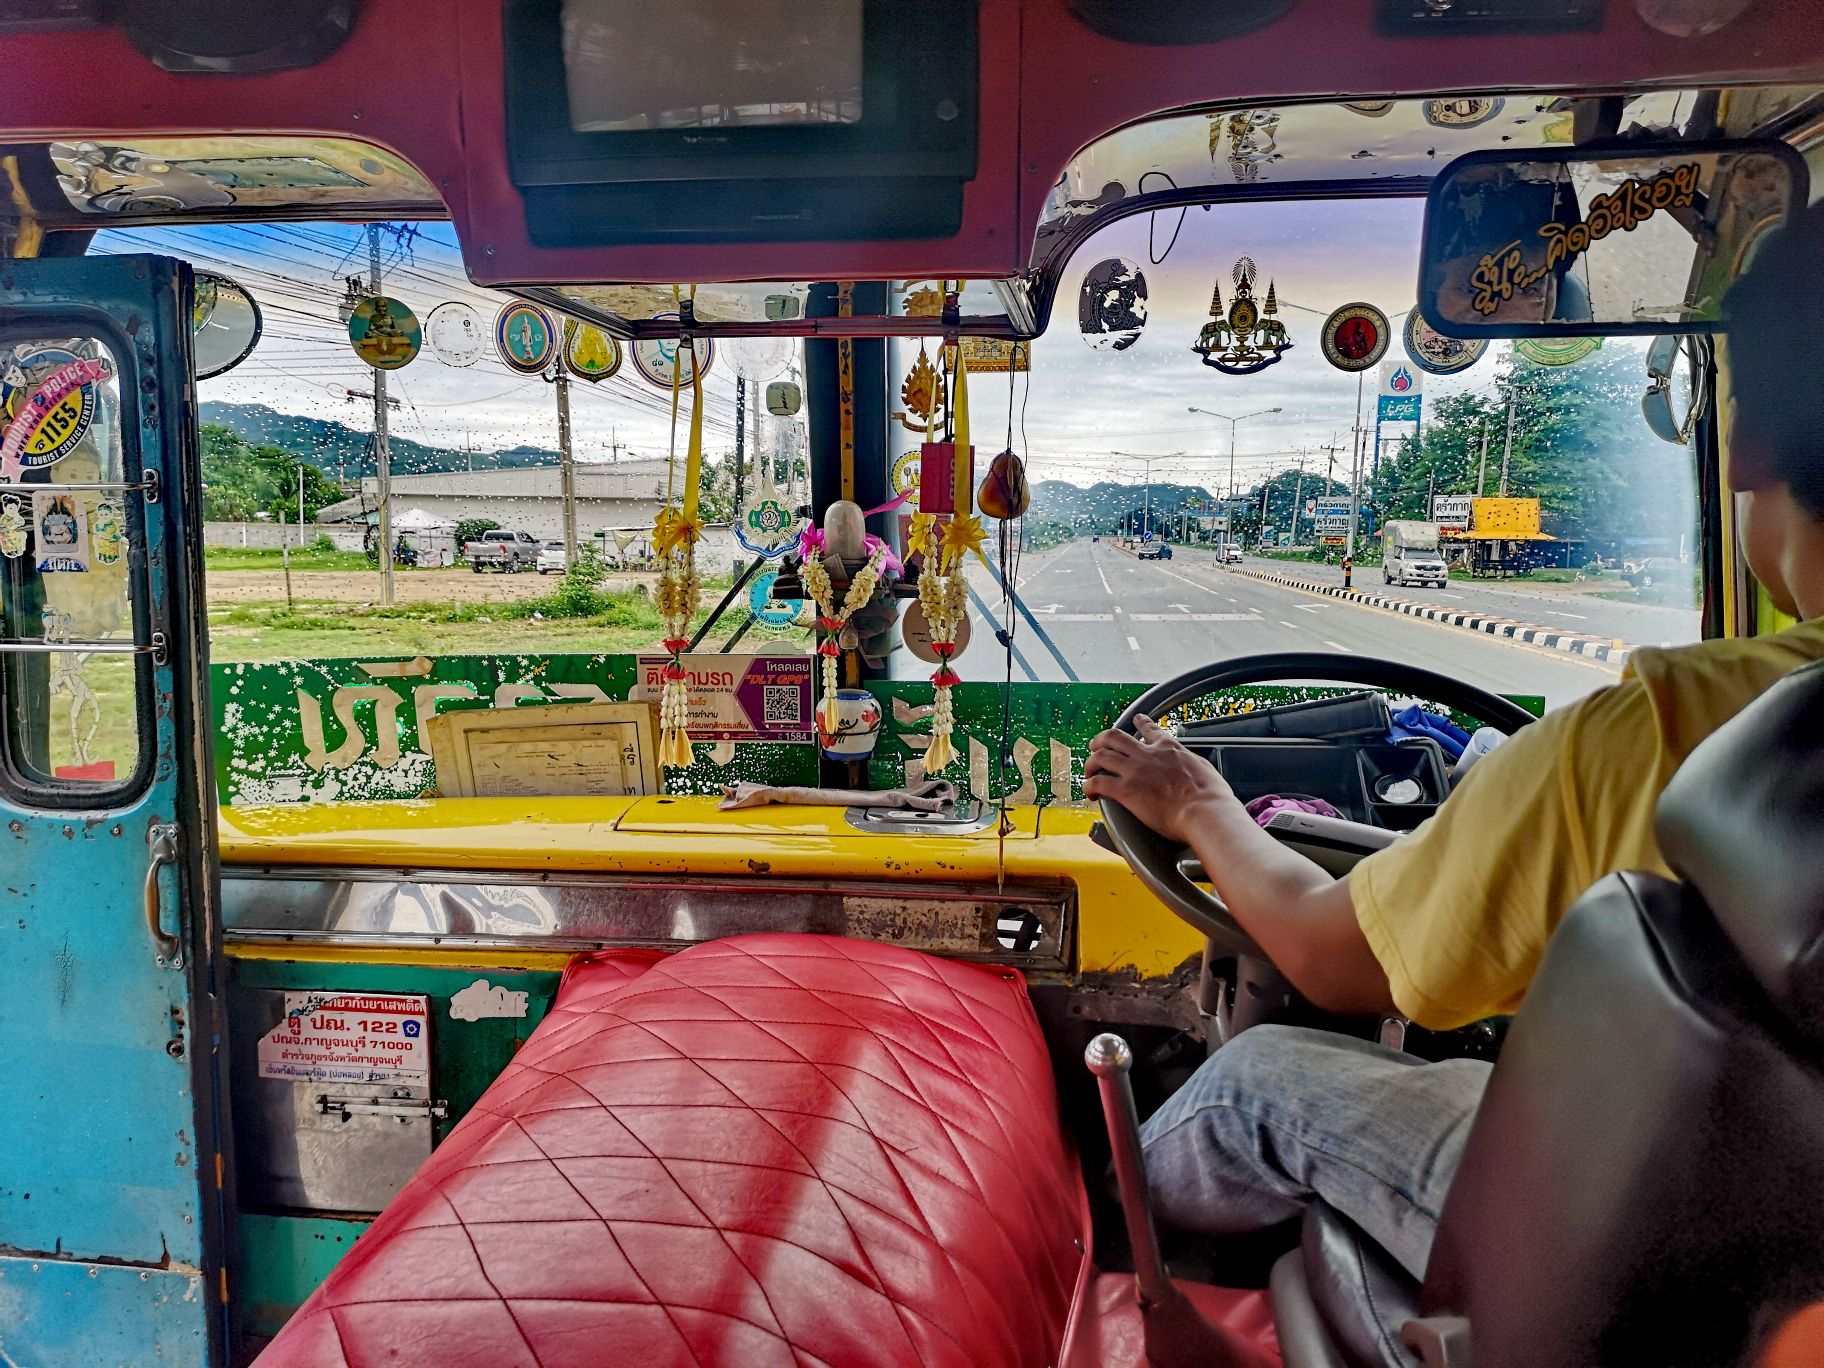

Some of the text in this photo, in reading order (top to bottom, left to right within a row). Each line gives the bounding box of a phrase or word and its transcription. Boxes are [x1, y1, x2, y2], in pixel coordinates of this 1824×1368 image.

[44, 362, 83, 397] POLICE
[1387, 403, 1414, 413] LPG
[28, 393, 92, 466] TOURIST SERVICE CENTER
[41, 401, 78, 444] 1155
[14, 434, 30, 459] WHEN
[29, 413, 43, 430] YOU
[766, 661, 809, 673] โหลดเลย
[785, 732, 807, 741] 1584
[311, 1014, 351, 1032] ปณ.
[357, 1020, 398, 1033] 122
[369, 1040, 413, 1050] 71000
